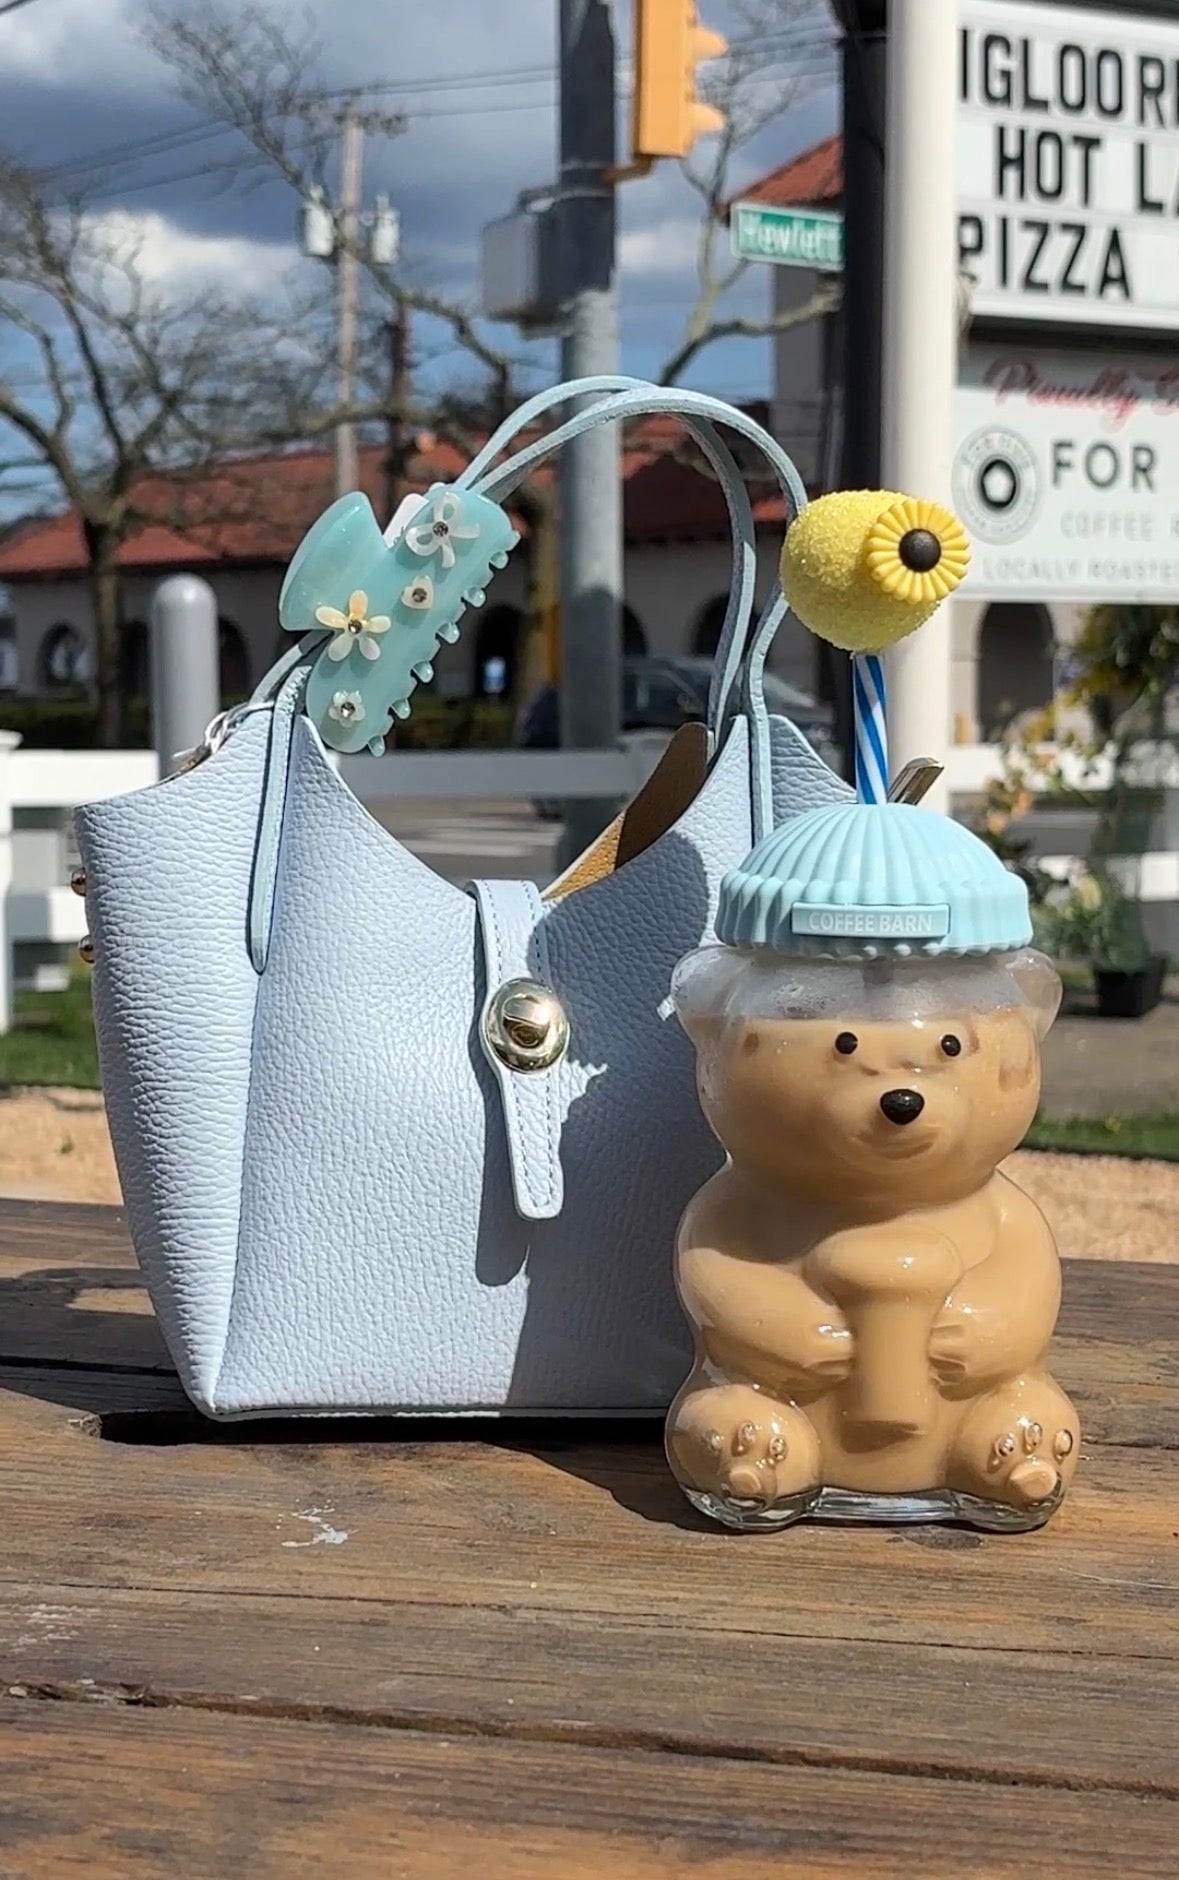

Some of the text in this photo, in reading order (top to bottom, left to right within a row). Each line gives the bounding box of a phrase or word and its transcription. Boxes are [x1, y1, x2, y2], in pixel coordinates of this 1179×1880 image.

[961, 28, 1179, 127] IGLOOR
[996, 125, 1179, 218] HOT L
[959, 214, 1131, 300] PIZZA
[1052, 439, 1157, 492] FOR
[1060, 511, 1154, 541] COFFEE
[1087, 556, 1179, 583] ROASTE
[808, 911, 932, 933] COFFEE BARN
